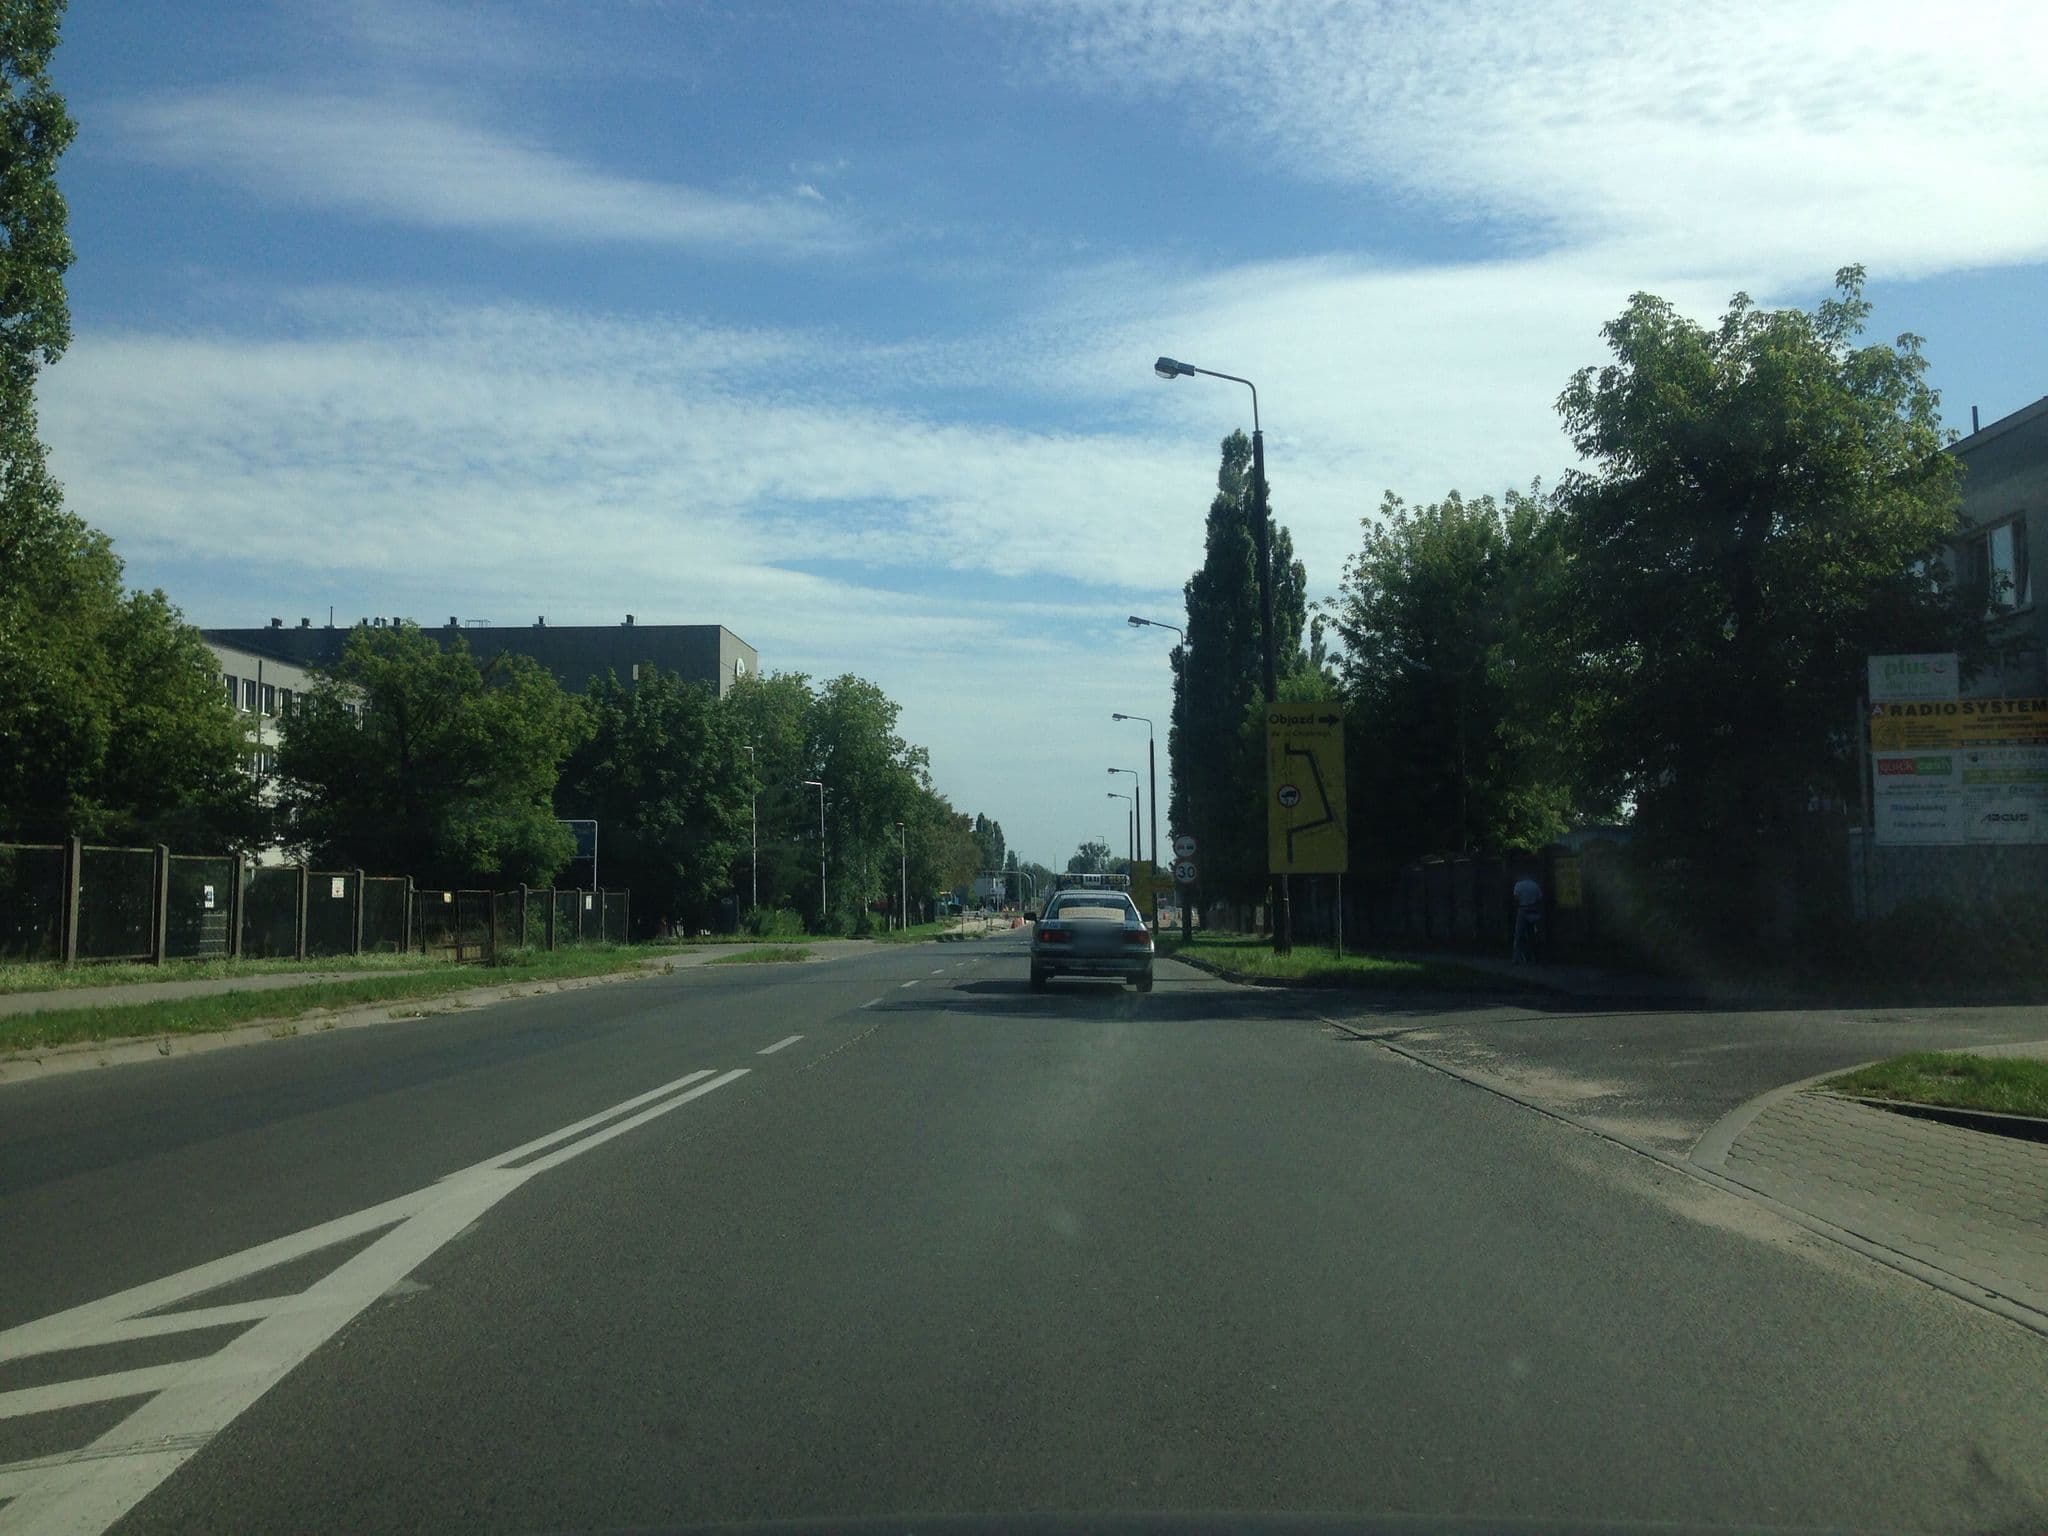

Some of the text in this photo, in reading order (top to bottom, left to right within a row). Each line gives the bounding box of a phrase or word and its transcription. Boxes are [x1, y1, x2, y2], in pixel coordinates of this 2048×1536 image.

[1885, 660, 1928, 678] plus
[1890, 703, 1957, 716] RADIO
[1962, 700, 2048, 714] SYSTEM
[1269, 713, 1314, 727] Objazd
[1880, 759, 1912, 772] quick
[1178, 866, 1195, 878] 30
